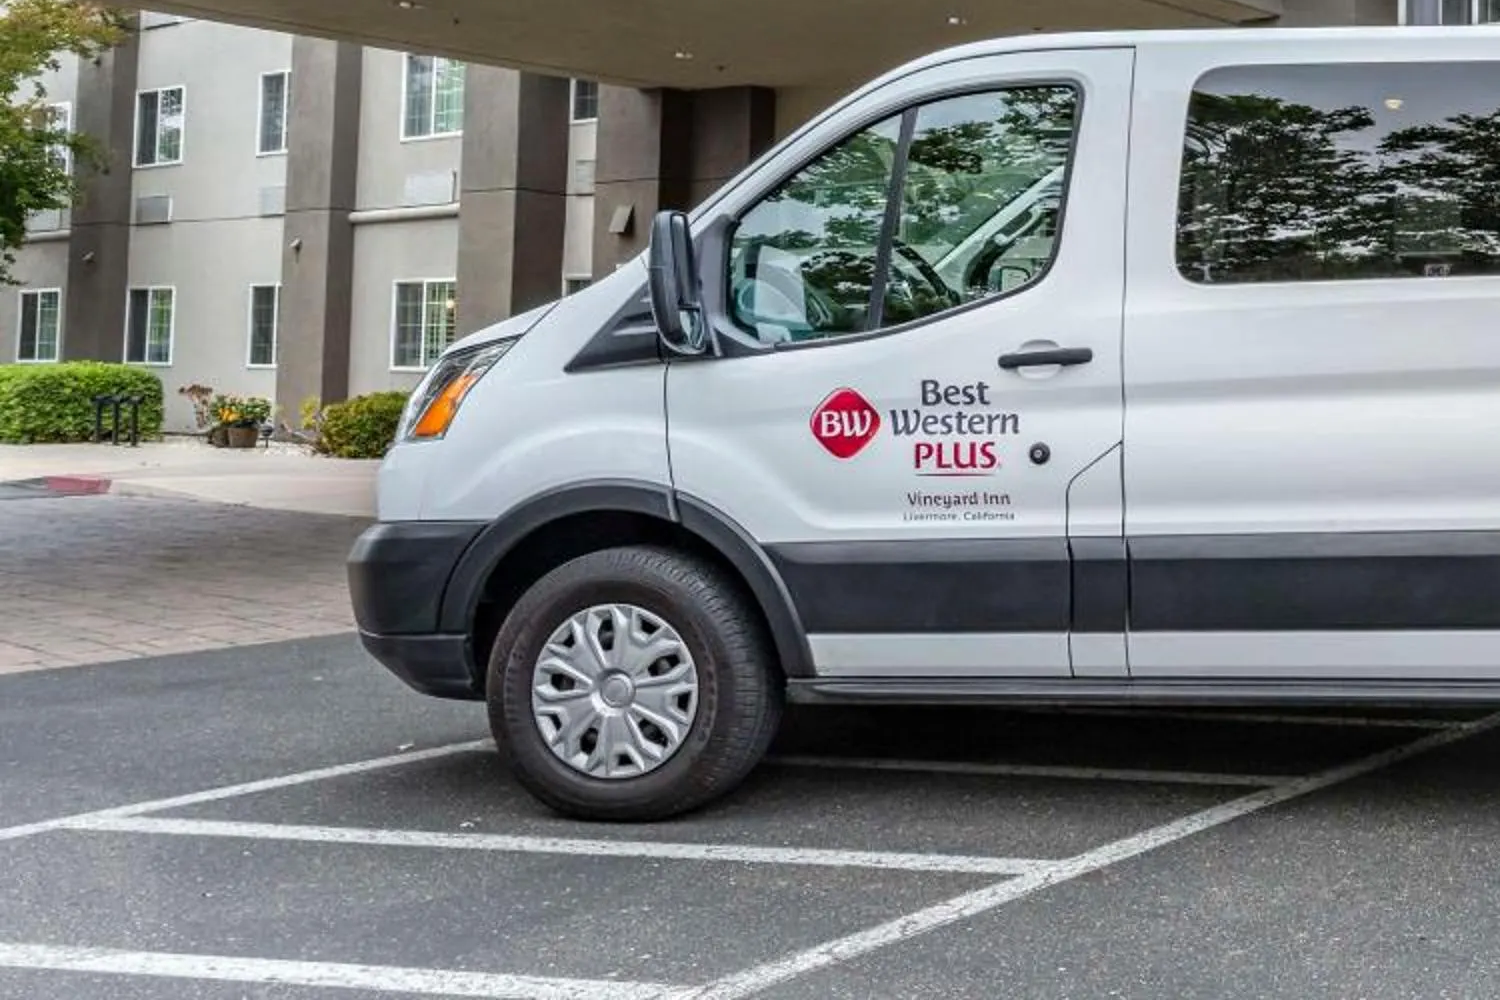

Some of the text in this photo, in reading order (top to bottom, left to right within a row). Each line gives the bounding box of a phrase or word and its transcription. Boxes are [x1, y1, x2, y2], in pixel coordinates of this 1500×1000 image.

[921, 379, 991, 406] Best
[820, 410, 872, 437] BW
[889, 409, 1020, 436] Western
[914, 441, 997, 469] PLUS
[907, 491, 1011, 509] Vineyard Inn
